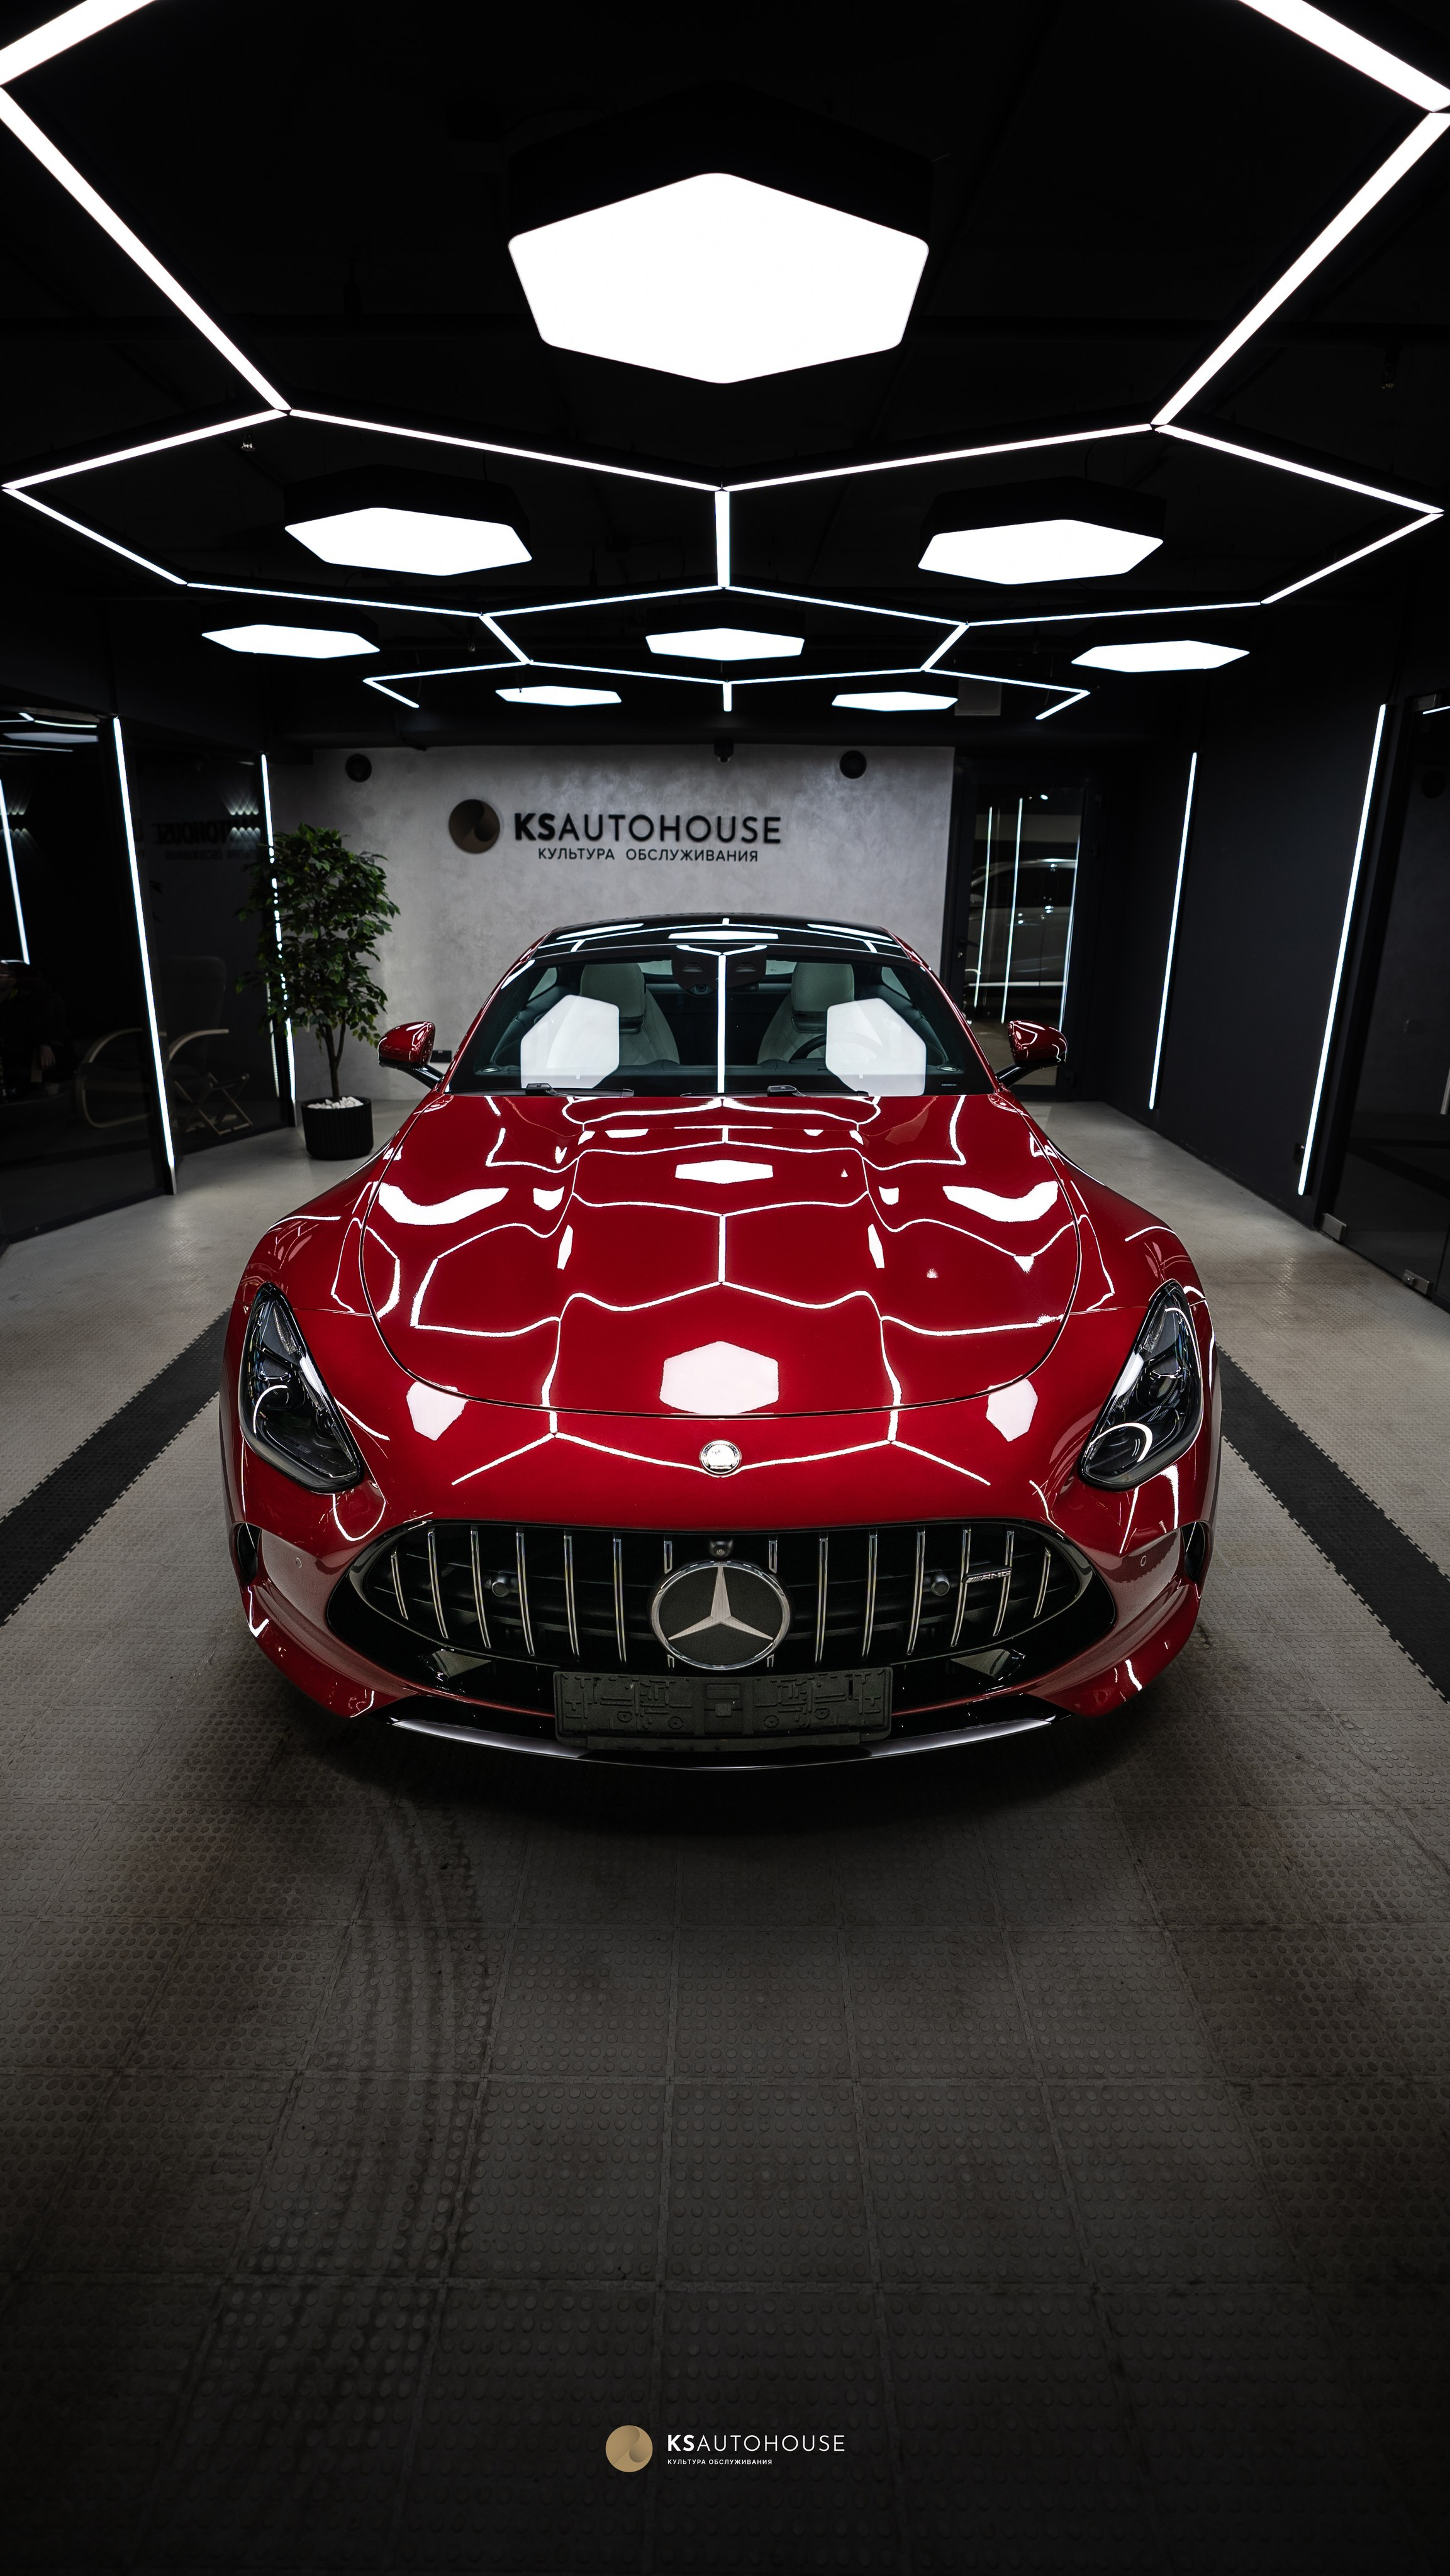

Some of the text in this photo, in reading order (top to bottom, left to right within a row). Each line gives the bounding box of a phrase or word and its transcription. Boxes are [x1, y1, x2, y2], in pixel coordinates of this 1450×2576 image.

[514, 813, 781, 844] KSAUTOHOUSE
[538, 848, 759, 862] КУЛЬТУРА ОБСЛУЖИВАНИЯ
[981, 1570, 1011, 1580] AMG
